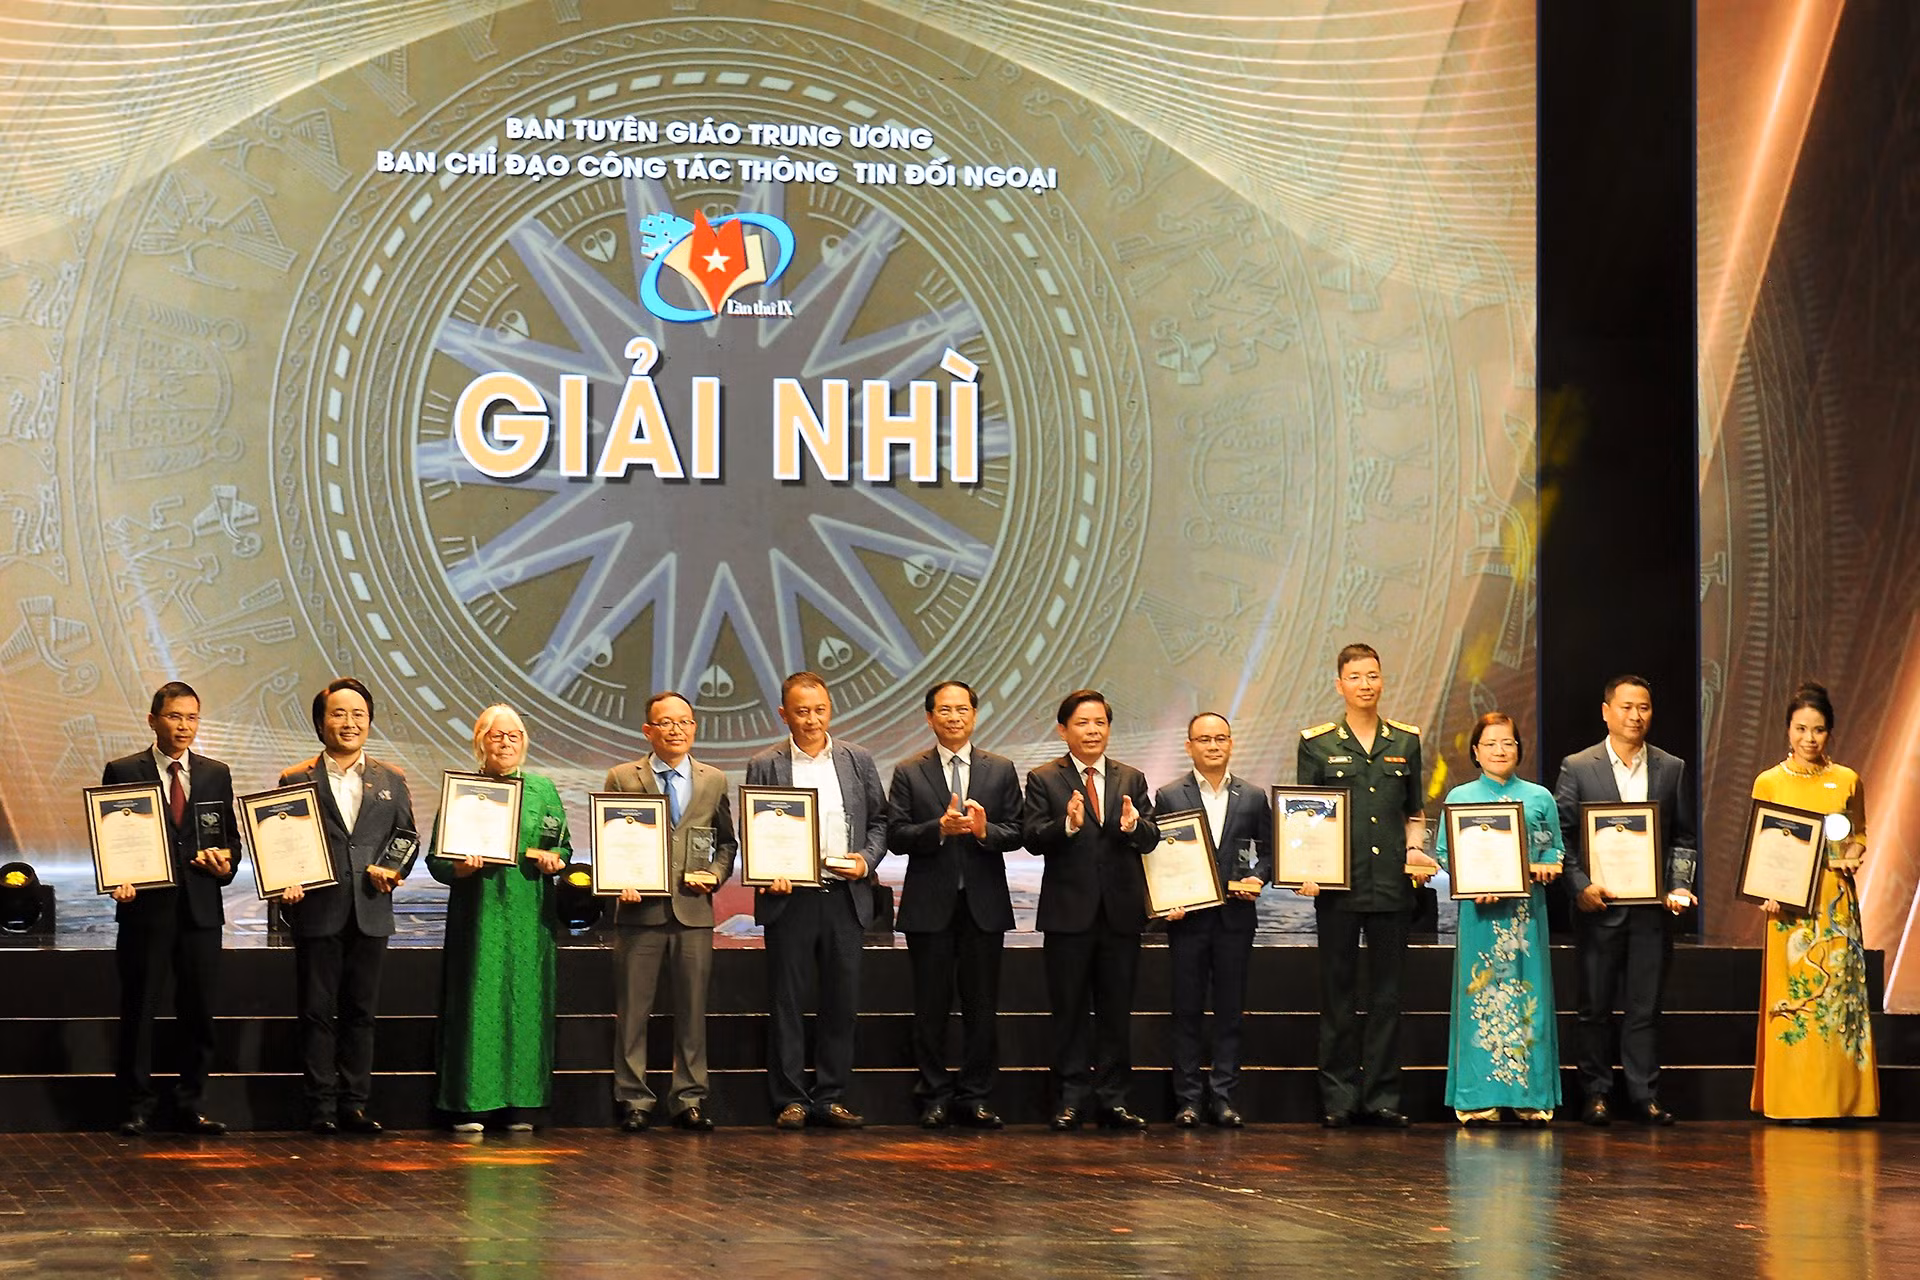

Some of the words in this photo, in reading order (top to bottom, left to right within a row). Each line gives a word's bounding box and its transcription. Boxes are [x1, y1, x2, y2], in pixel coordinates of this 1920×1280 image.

[506, 116, 565, 141] BAN
[572, 115, 658, 143] TUYÊN
[666, 117, 741, 145] GIÁO
[748, 123, 842, 148] TRUNG
[849, 124, 934, 150] ƯƠNG
[376, 150, 437, 173] BAN
[444, 146, 497, 175] CHỈ
[504, 153, 571, 181] ĐẠO
[577, 151, 668, 179] CÔNG
[673, 153, 732, 181] TÁC
[738, 155, 839, 183] THÔNG
[853, 162, 898, 185] TIN
[904, 157, 956, 187] ĐỐI
[964, 165, 1056, 194] NGOẠI
[454, 336, 720, 479] GIẢI
[773, 346, 979, 483] NHÌ
